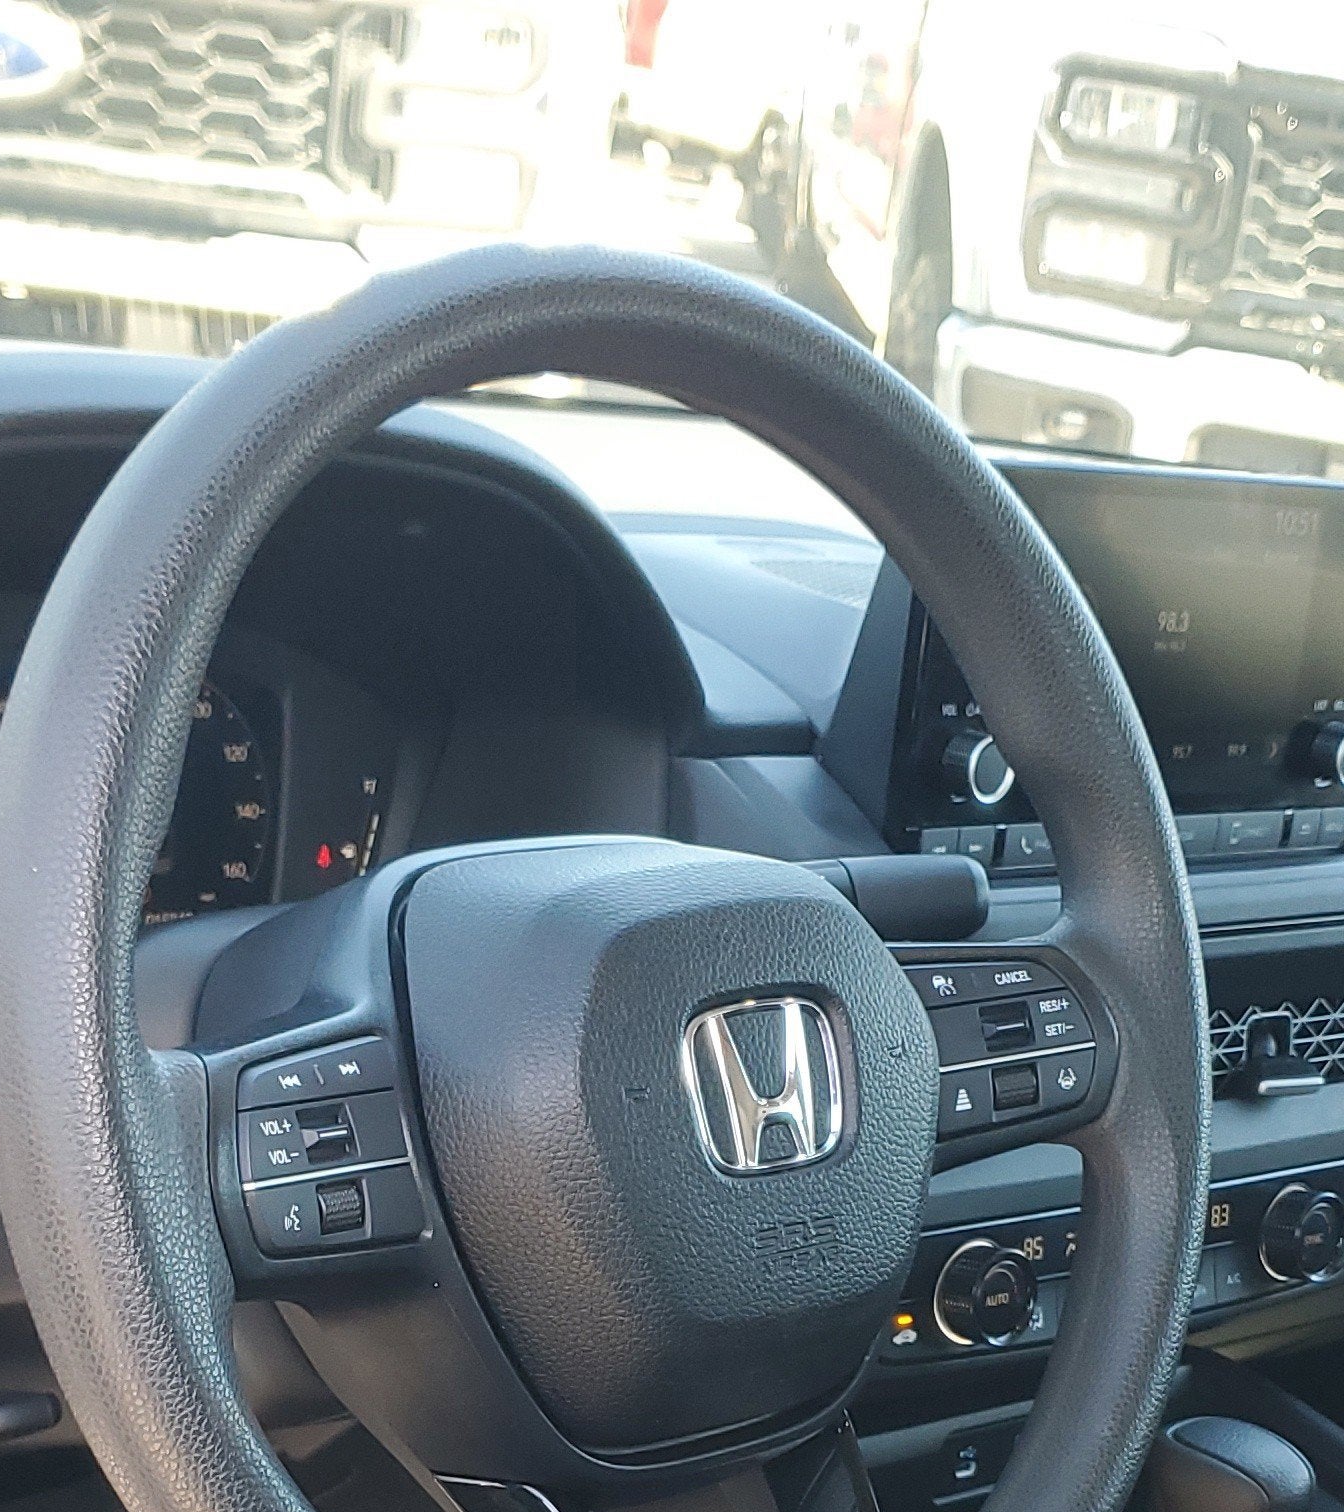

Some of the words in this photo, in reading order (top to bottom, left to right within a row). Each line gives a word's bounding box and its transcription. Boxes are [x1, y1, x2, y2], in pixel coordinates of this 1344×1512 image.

[994, 969, 1032, 986] CANCEL
[259, 1118, 292, 1137] VOL+
[985, 1292, 1010, 1307] AUTO
